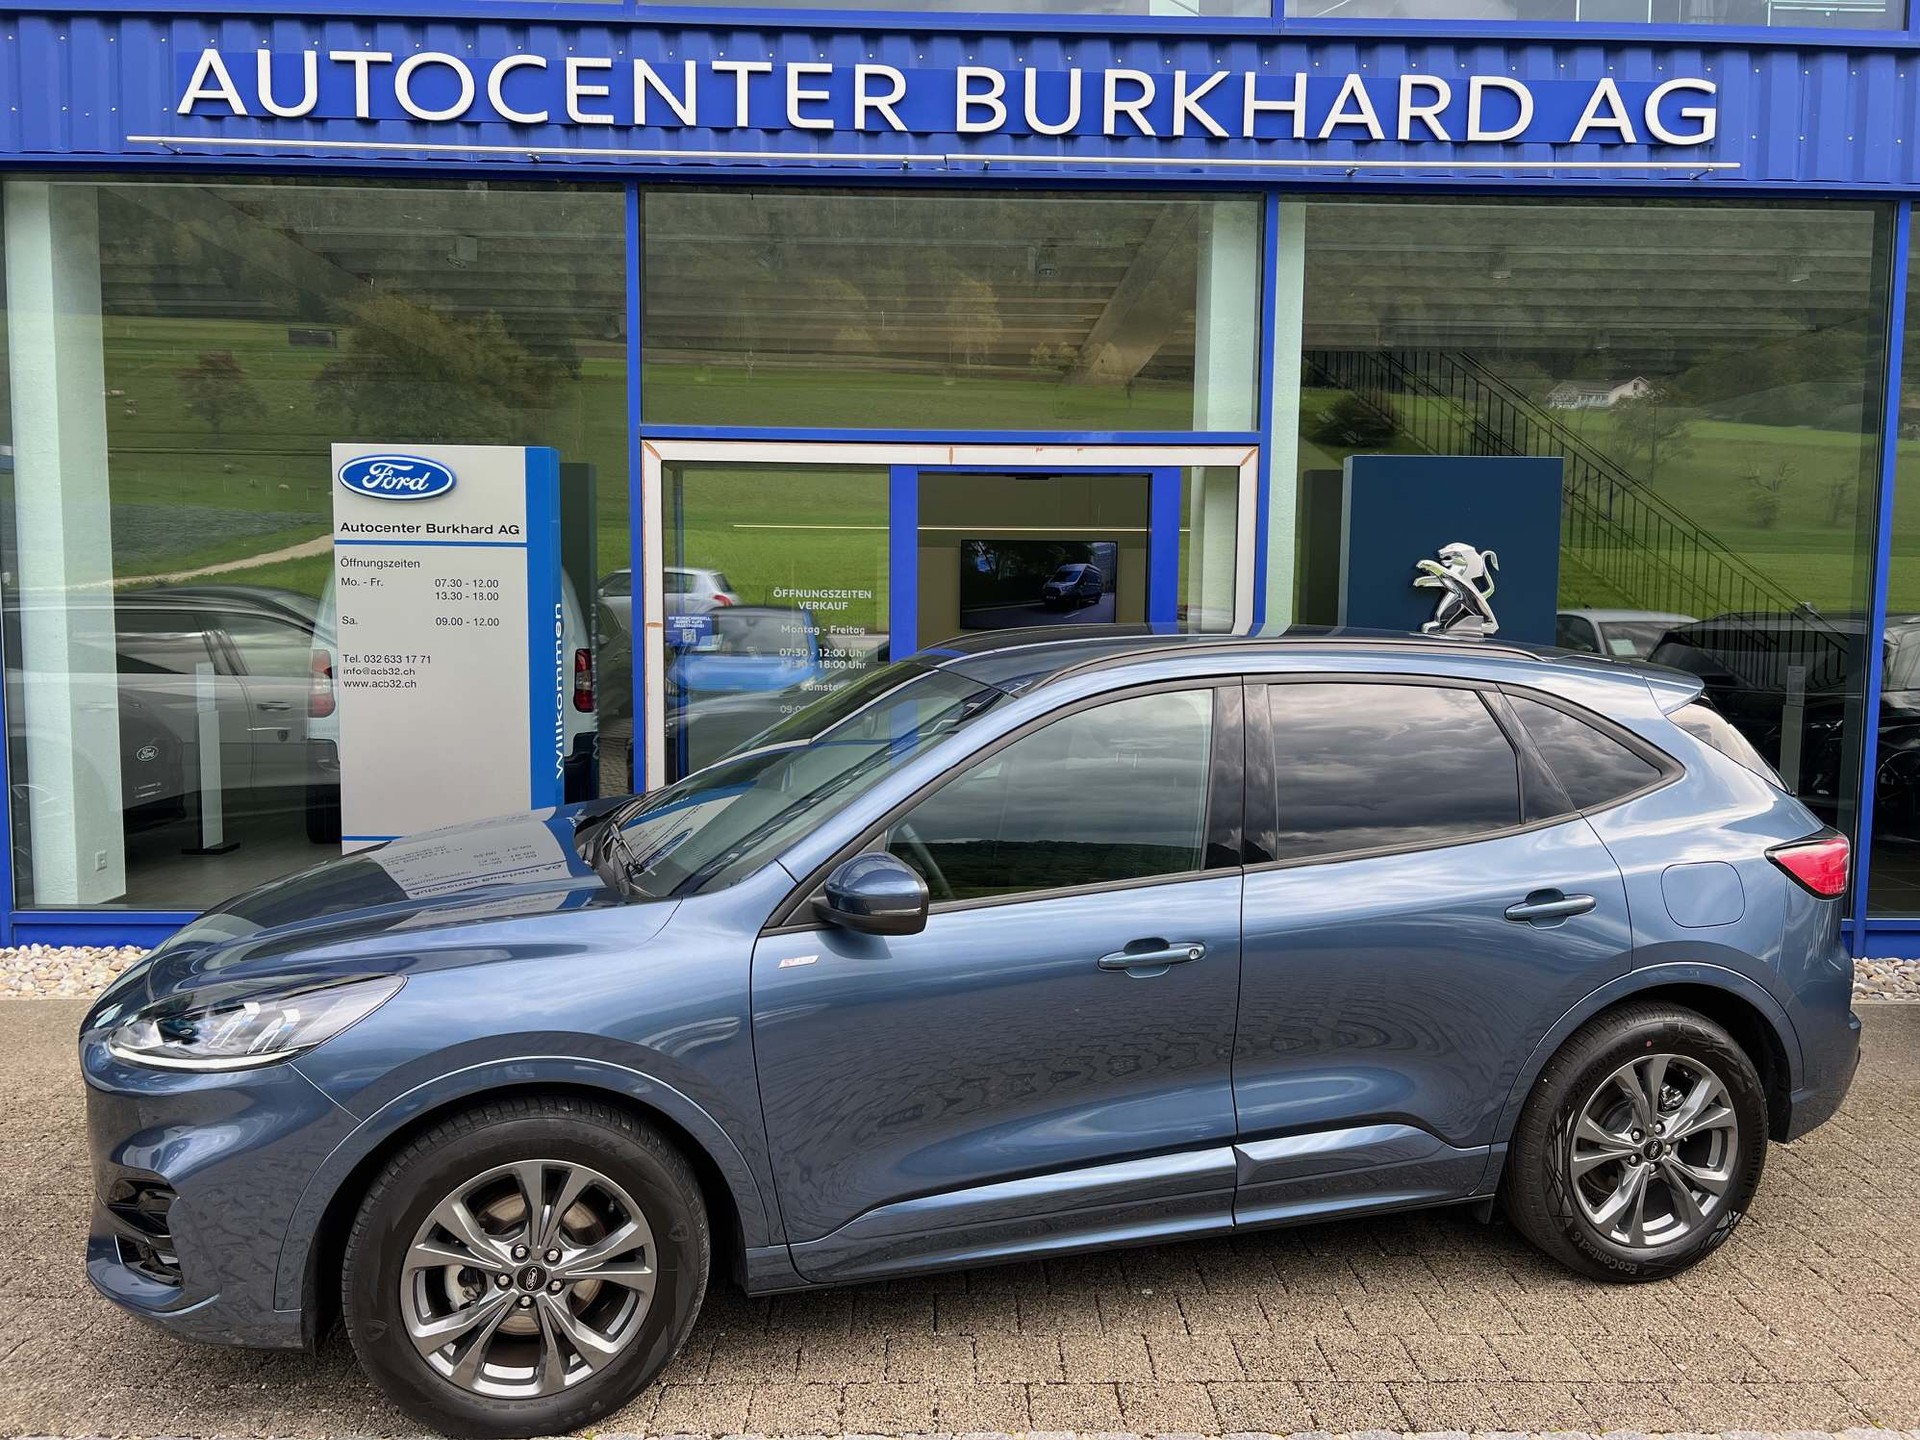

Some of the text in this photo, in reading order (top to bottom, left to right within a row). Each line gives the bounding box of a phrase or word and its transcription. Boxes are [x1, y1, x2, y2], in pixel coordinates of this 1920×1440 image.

[177, 48, 1718, 147] AUTOCENTER BURKHARD AG
[362, 462, 431, 491] Ford
[340, 522, 520, 535] Autocenter Burkhard AG
[340, 556, 421, 570] Öffnungszeiten
[340, 577, 360, 587] Mo.
[370, 577, 384, 587] Fr.
[434, 578, 462, 588] 07.30
[473, 579, 499, 588] 12.00
[435, 591, 462, 601] 13.30
[473, 591, 499, 601] 18.00
[773, 586, 872, 599] ÖFFNUNGSZEITEN
[797, 601, 849, 611] VERKAUF
[341, 615, 358, 626] Sa.
[435, 617, 463, 626] 09.00
[474, 617, 500, 627] 12.00
[781, 624, 820, 636] Montag
[830, 624, 866, 636] Freitag
[779, 648, 809, 658] 07:30
[818, 648, 846, 658] 12:00
[848, 648, 867, 658] Uhr
[342, 654, 431, 664] Tel. 032 633 17 71
[818, 660, 846, 669] 18:00
[848, 660, 867, 669] Uhr
[343, 667, 416, 676] info@acb32.ch
[343, 679, 417, 689] www.acb32.ch
[801, 682, 841, 692] amsta
[554, 603, 564, 780] Willkommen
[779, 704, 807, 714] 09:0
[1579, 1238, 1639, 1275] EcoContact
